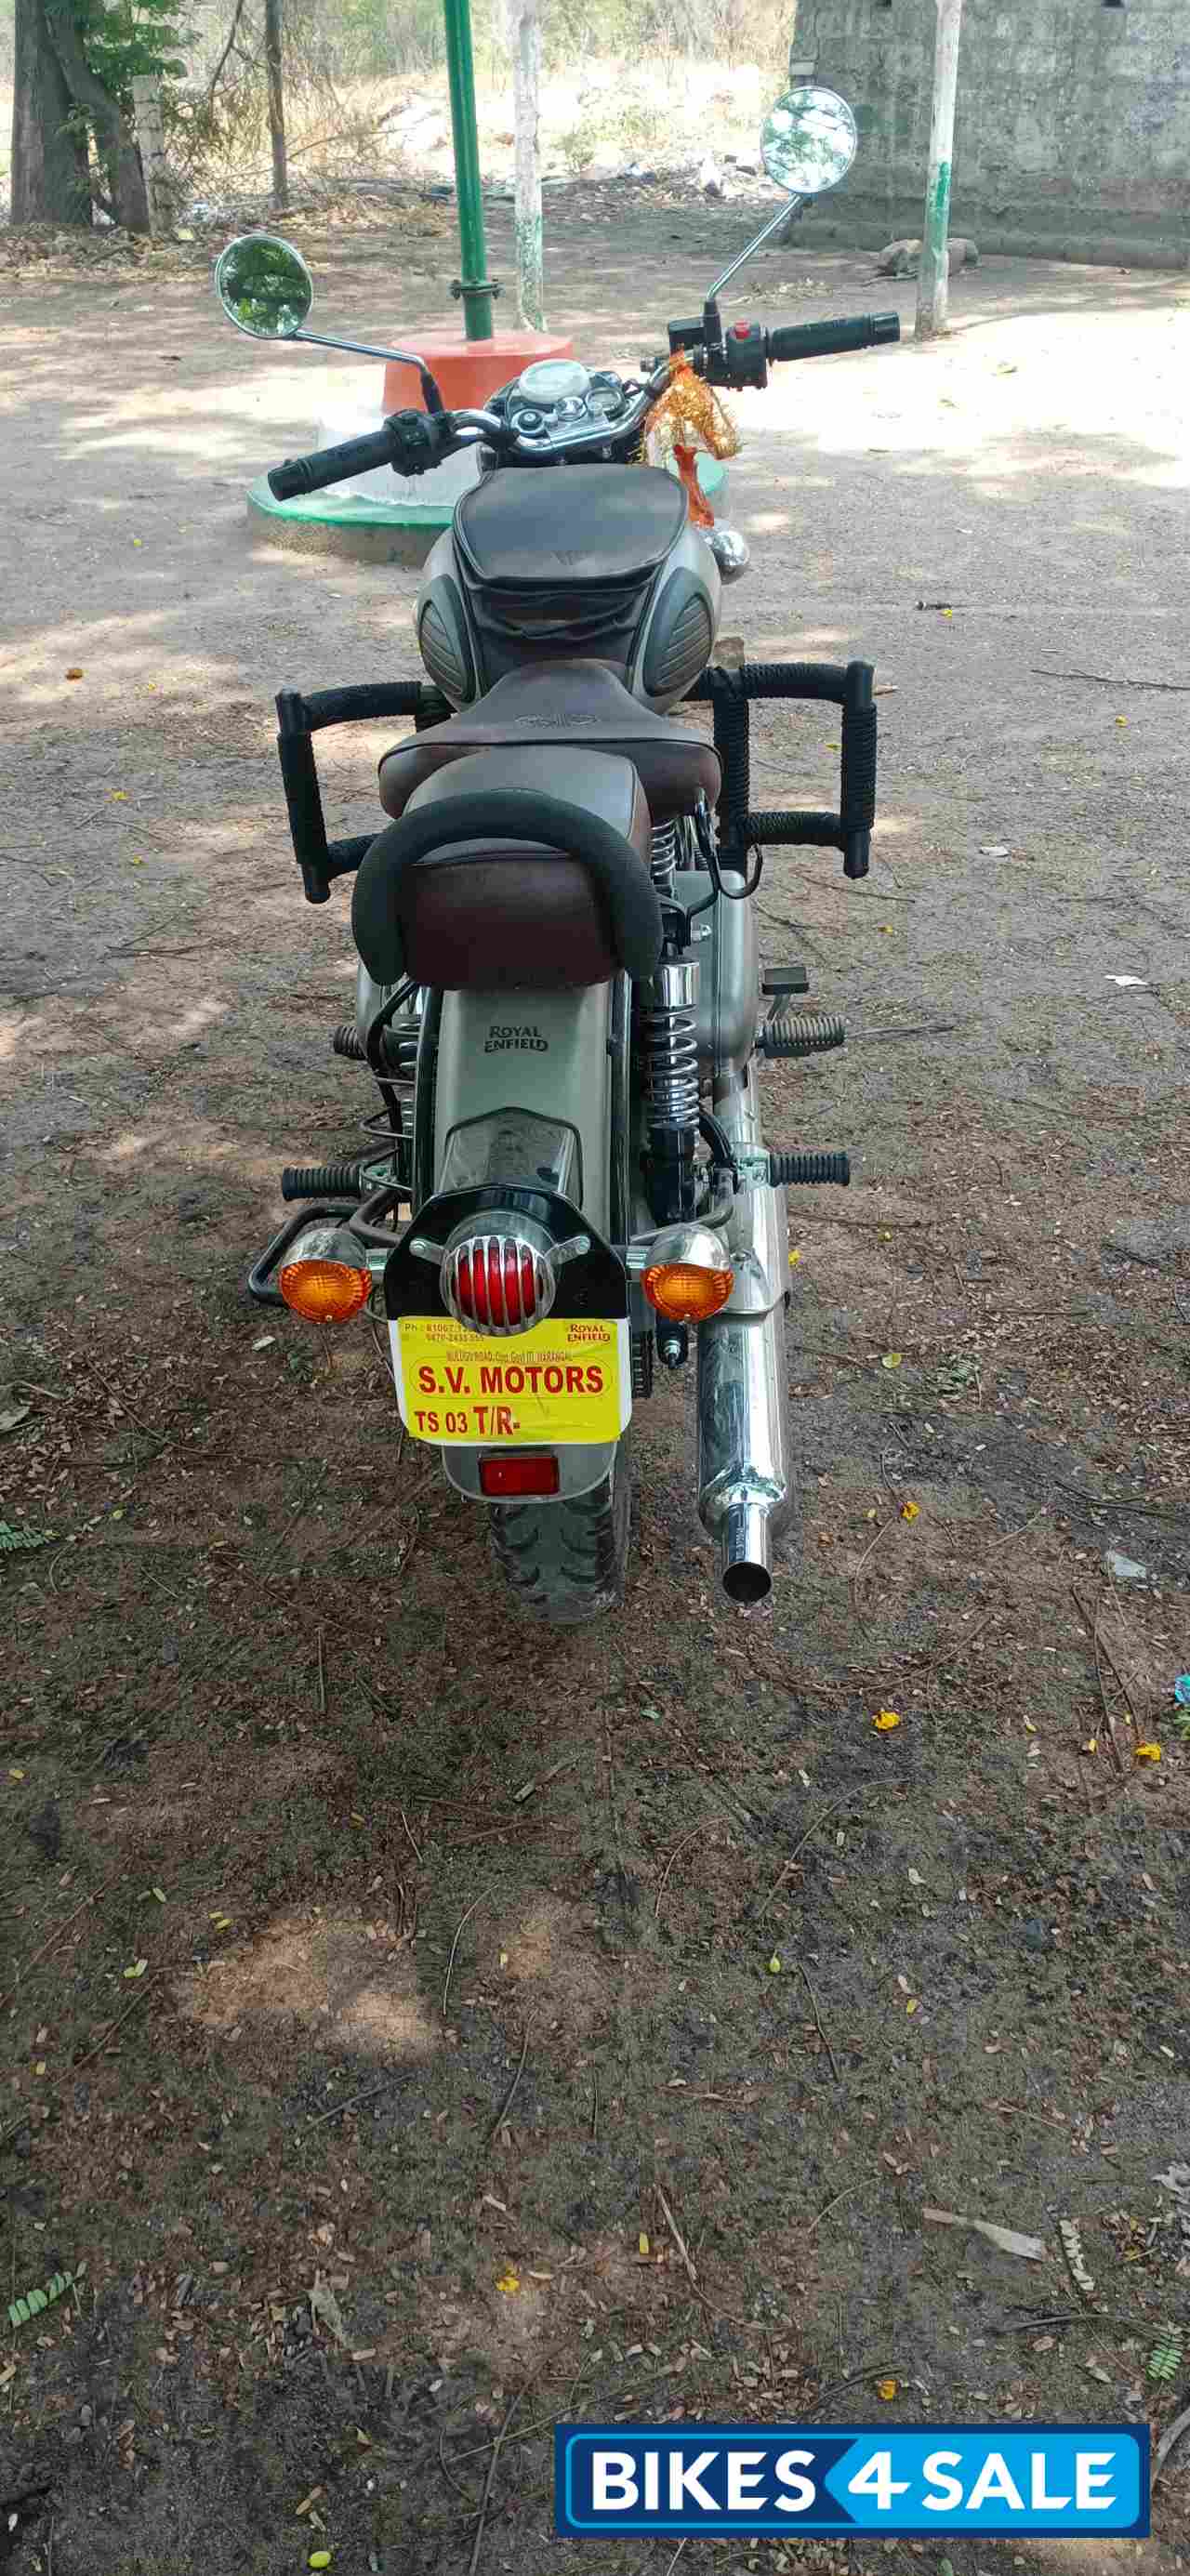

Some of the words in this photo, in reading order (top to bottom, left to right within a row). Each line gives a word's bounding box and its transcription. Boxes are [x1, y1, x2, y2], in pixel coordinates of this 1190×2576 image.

[489, 1026, 542, 1038] ROYAL
[484, 1038, 549, 1053] ENFIELD
[570, 1324, 604, 1333] ROYAL
[567, 1332, 611, 1342] ENFIELD
[418, 1366, 471, 1394] S.V.
[481, 1366, 603, 1394] MOTORS
[415, 1410, 440, 1433] TS
[445, 1411, 468, 1433] 03
[473, 1406, 521, 1435] T/R-
